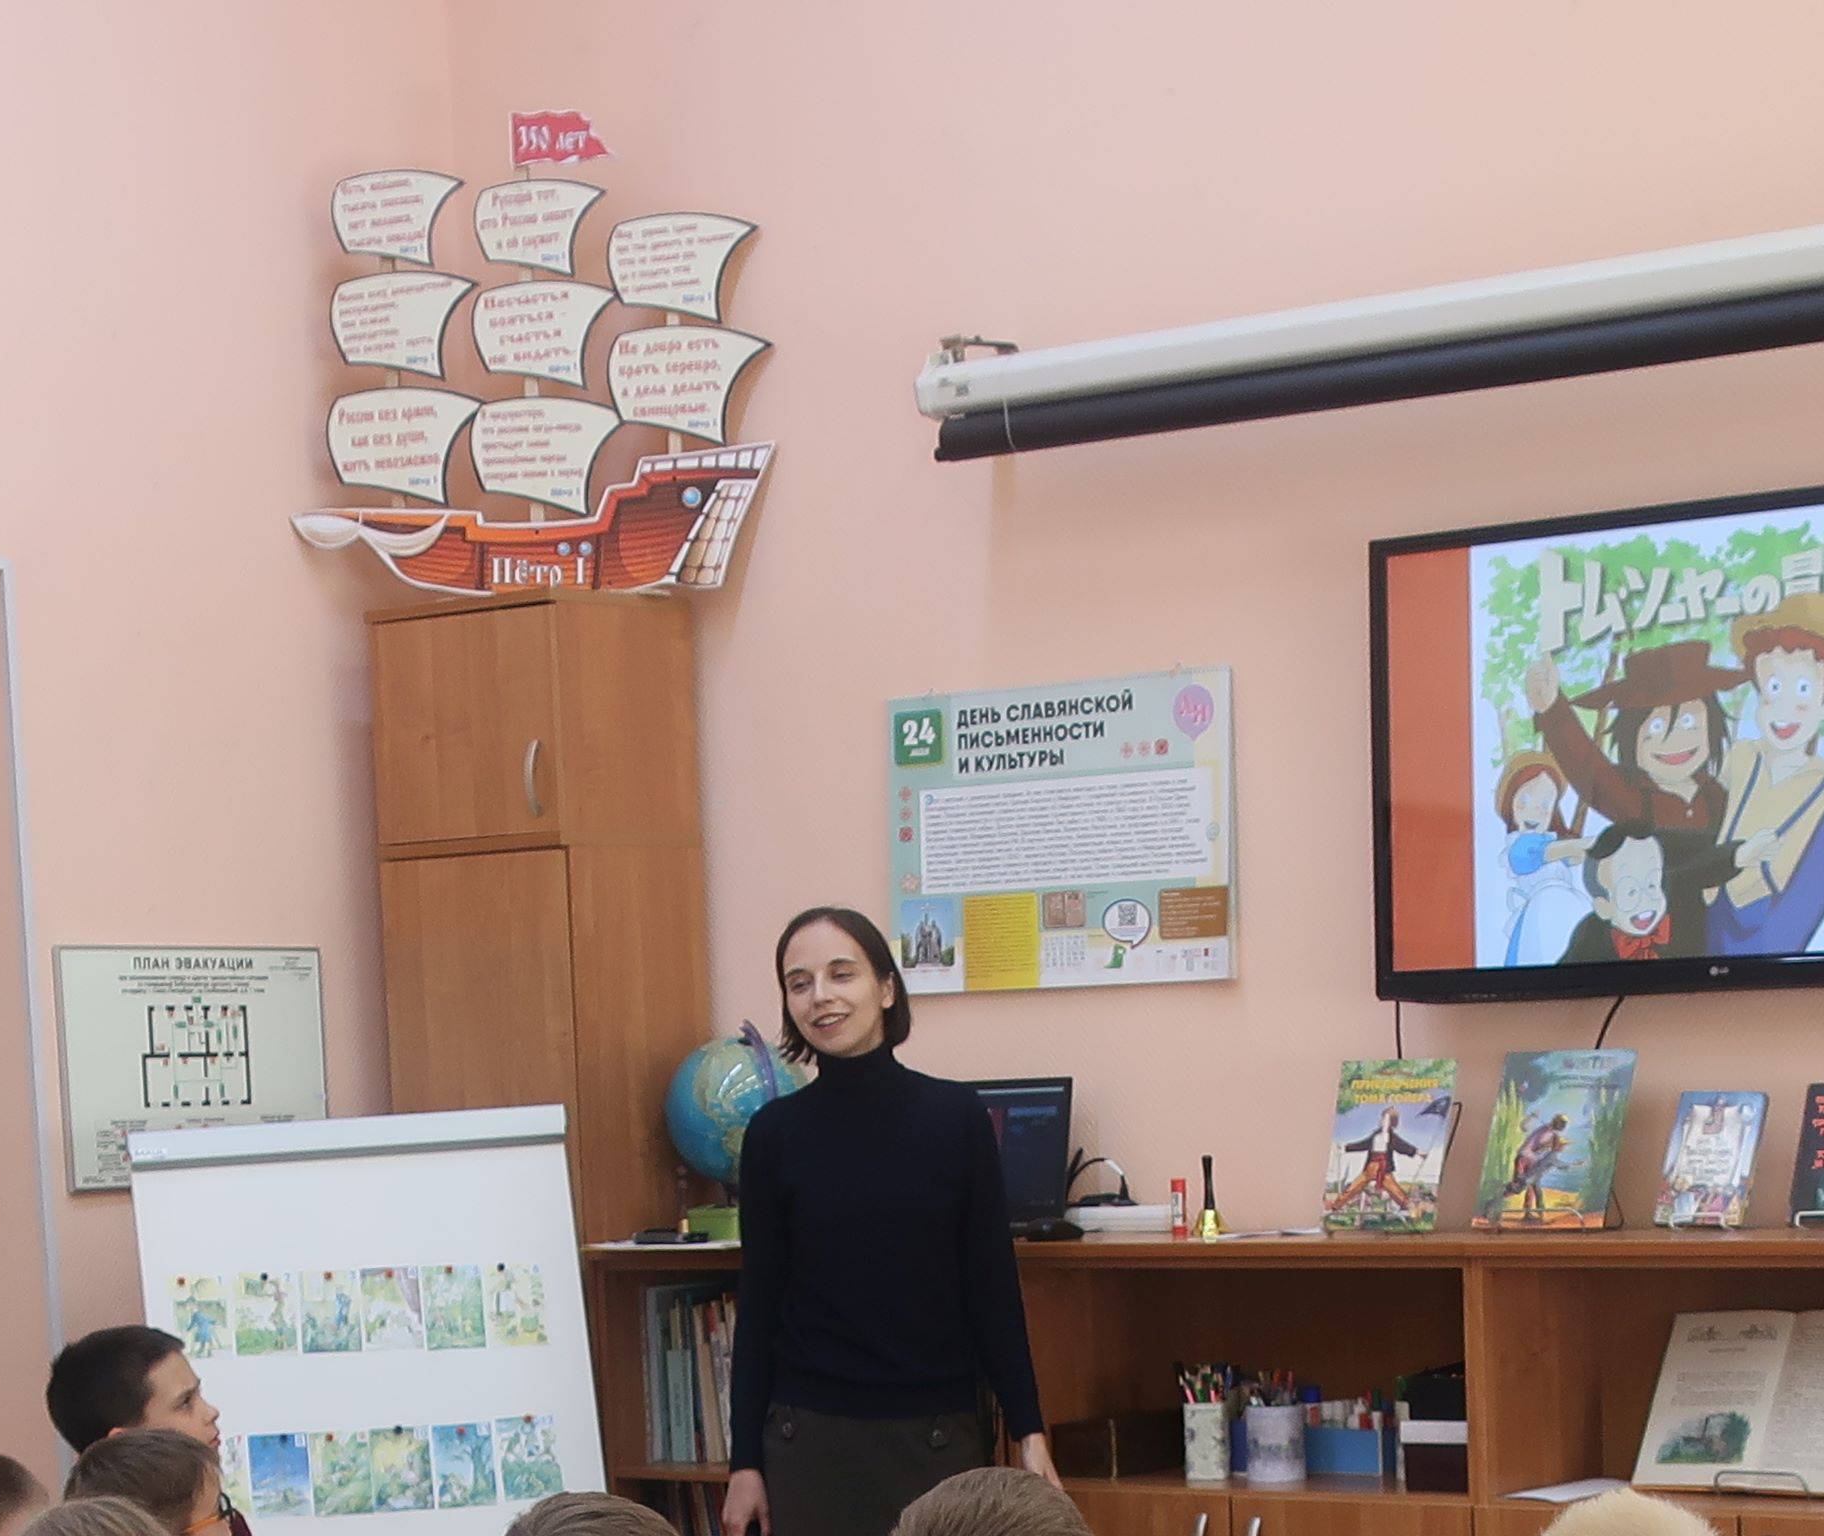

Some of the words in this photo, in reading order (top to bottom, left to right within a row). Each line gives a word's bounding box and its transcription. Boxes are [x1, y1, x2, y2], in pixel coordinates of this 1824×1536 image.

[492, 557, 562, 587] Пётр
[576, 557, 586, 584] I
[956, 707, 1002, 730] ДЕНЬ
[1006, 688, 1134, 722] СЛАВЯНСКОЙ
[902, 717, 936, 747] 24
[957, 719, 1105, 750] ПИСЬМЕННОСТИ
[958, 757, 970, 775] И
[974, 749, 1065, 773] КУЛЬТУРЫ
[133, 956, 170, 970] ПЛАН
[175, 956, 254, 971] ЭВАКУАЦИИ
